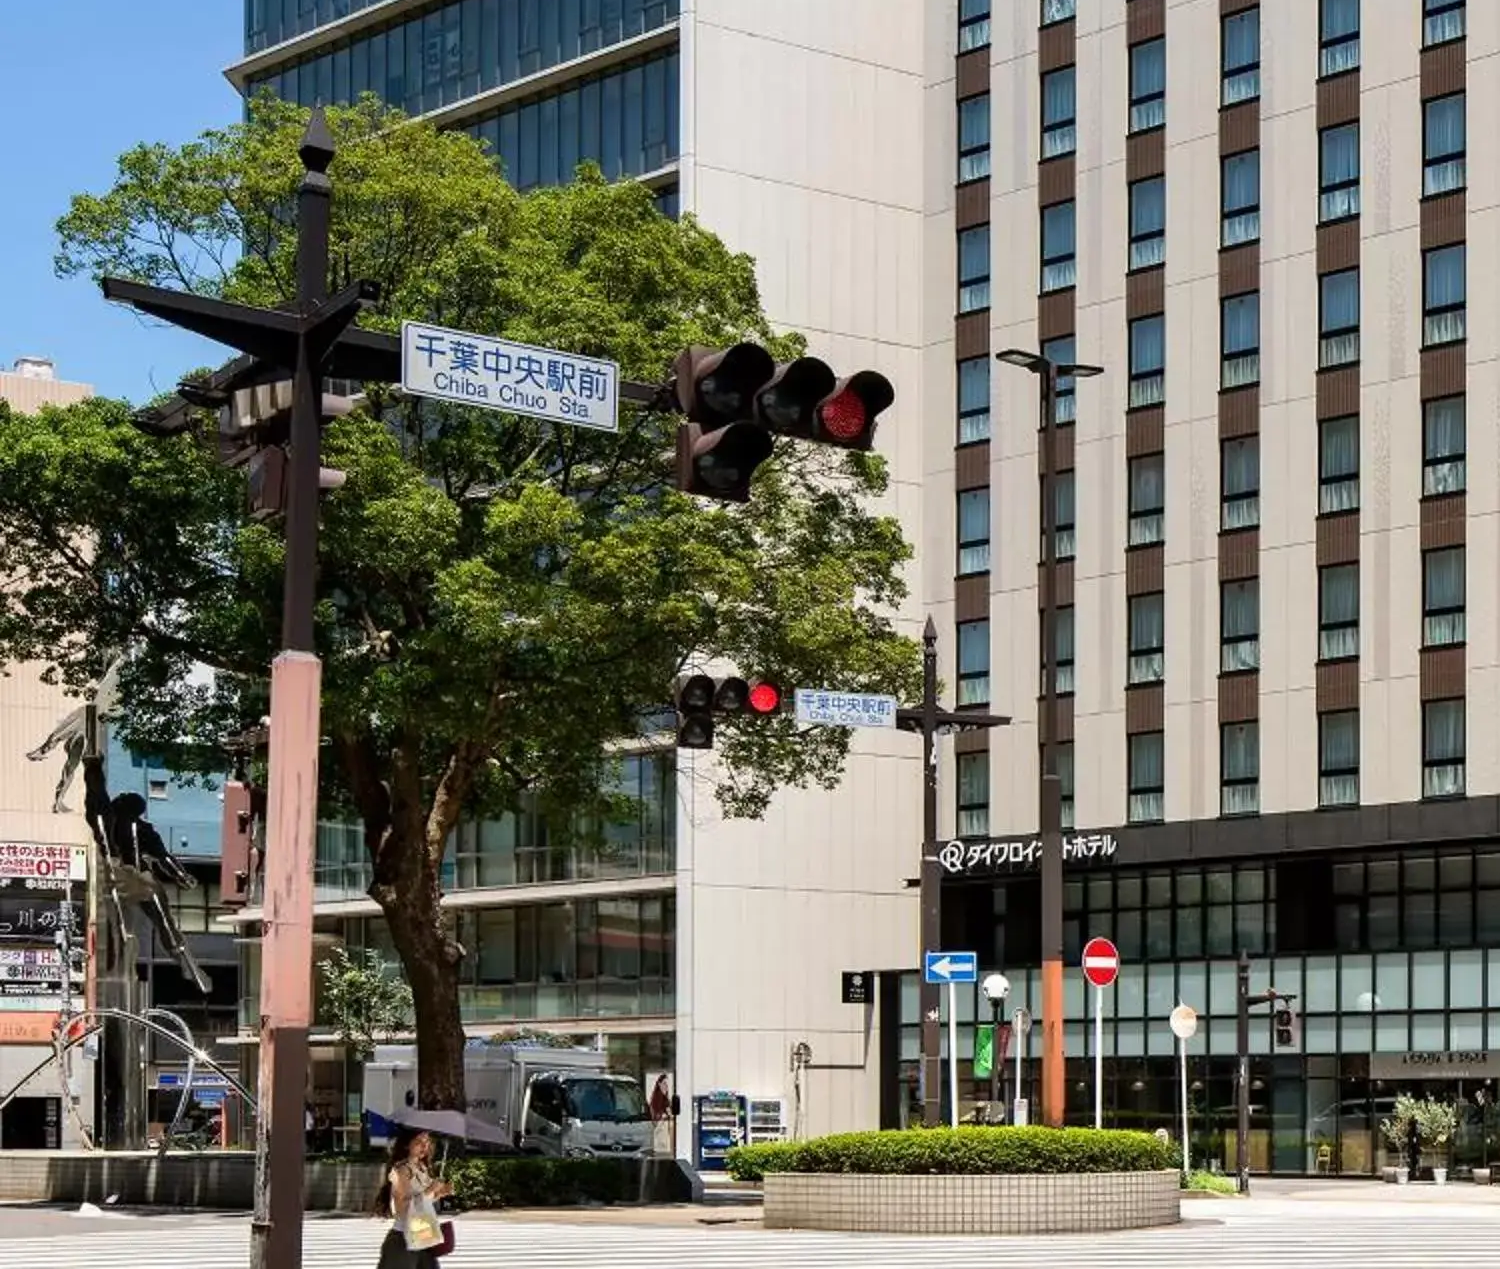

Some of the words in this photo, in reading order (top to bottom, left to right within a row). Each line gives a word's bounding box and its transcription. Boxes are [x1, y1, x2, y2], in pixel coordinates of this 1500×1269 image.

[415, 334, 608, 402] 千葉中央駅前
[433, 372, 489, 399] Chiba
[499, 384, 547, 411] Chuo
[559, 396, 592, 419] Sta.
[801, 694, 891, 716] 千葉中央駅前
[967, 835, 1117, 868] ダイワロイトホテル
